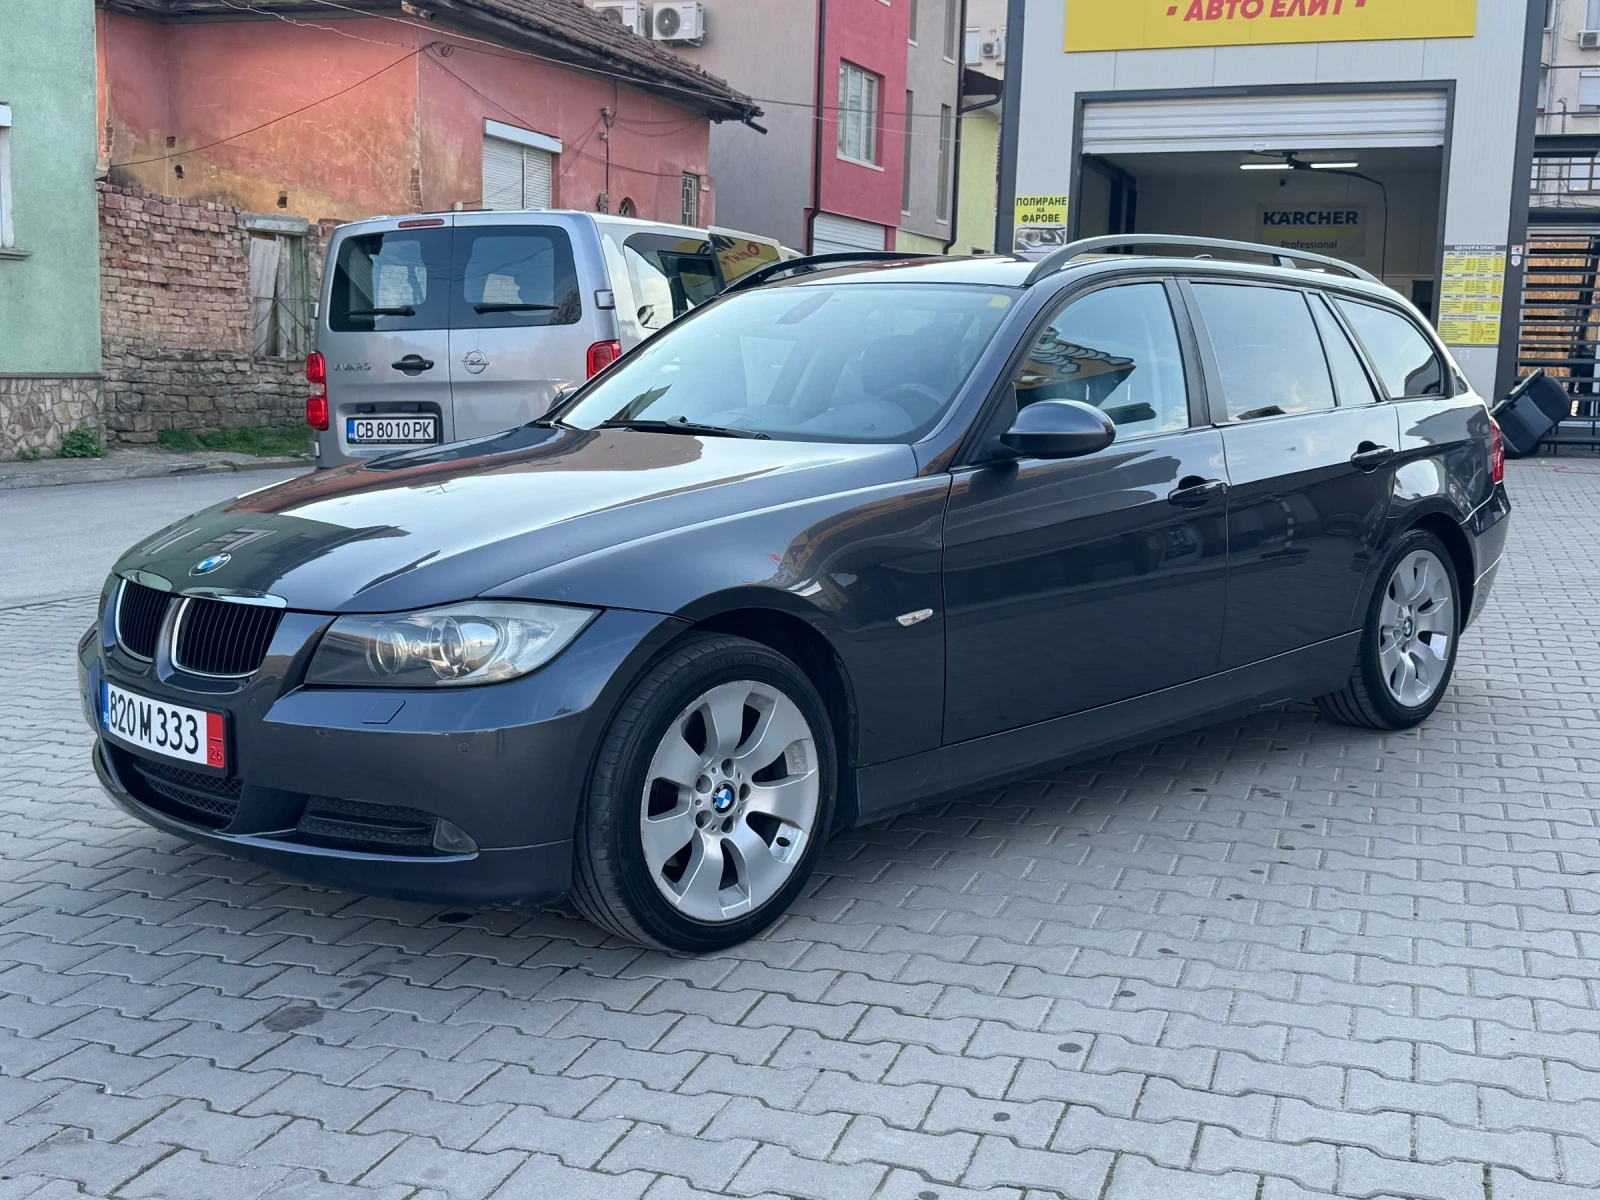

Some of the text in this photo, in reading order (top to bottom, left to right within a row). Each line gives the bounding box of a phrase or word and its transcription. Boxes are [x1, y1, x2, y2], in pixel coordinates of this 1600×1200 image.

[1183, 0, 1343, 21] АВТО ЕЛИТ
[1016, 197, 1067, 206] ПОЛИРАНЕ
[1021, 214, 1060, 222] ФАРОВЕ
[1263, 211, 1358, 225] KÄRCHER
[1280, 240, 1338, 249] Professional
[332, 363, 371, 371] VIVARO
[356, 422, 432, 438] CB 8010 PK
[110, 690, 199, 754] 820 M 333
[210, 747, 222, 760] 26
